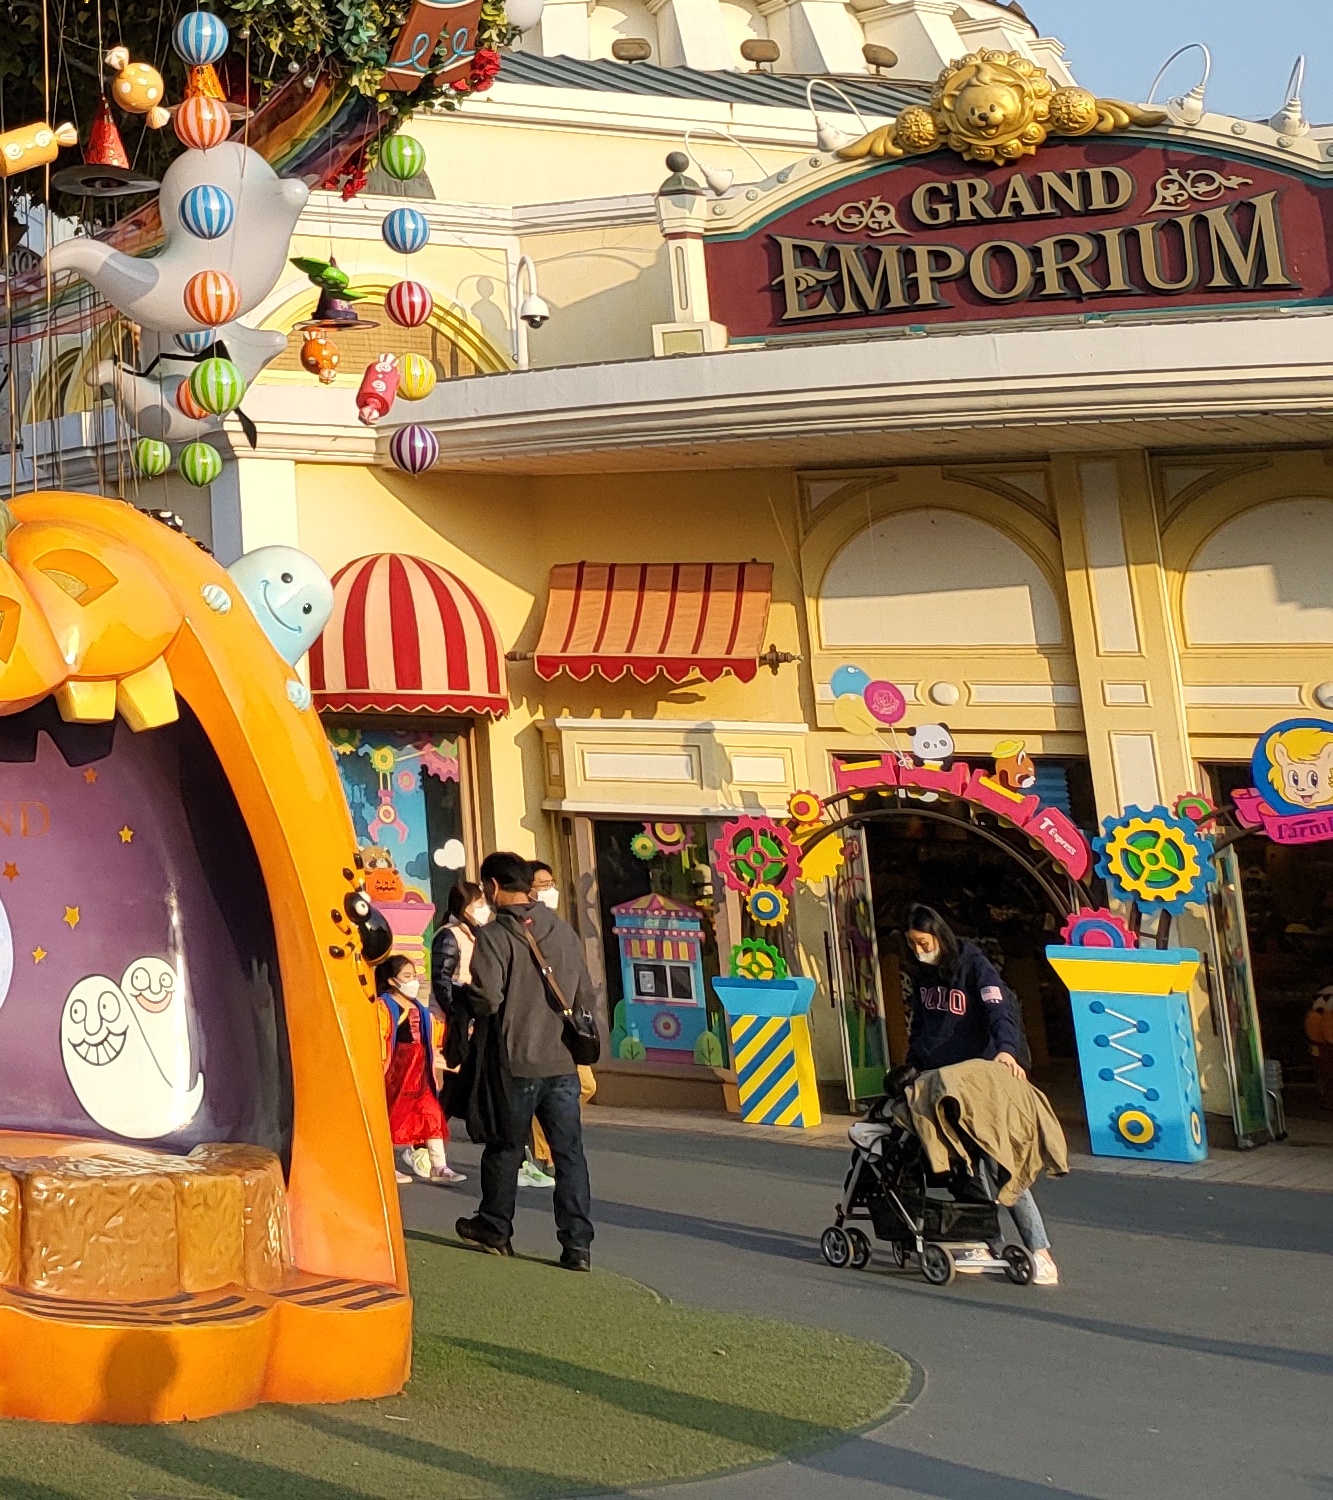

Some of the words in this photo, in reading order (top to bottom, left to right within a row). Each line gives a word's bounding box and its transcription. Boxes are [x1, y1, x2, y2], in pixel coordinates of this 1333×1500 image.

[912, 166, 1133, 228] GRAND
[770, 189, 1295, 321] EMPORIUM
[1039, 816, 1055, 830] T
[1048, 827, 1077, 856] Express
